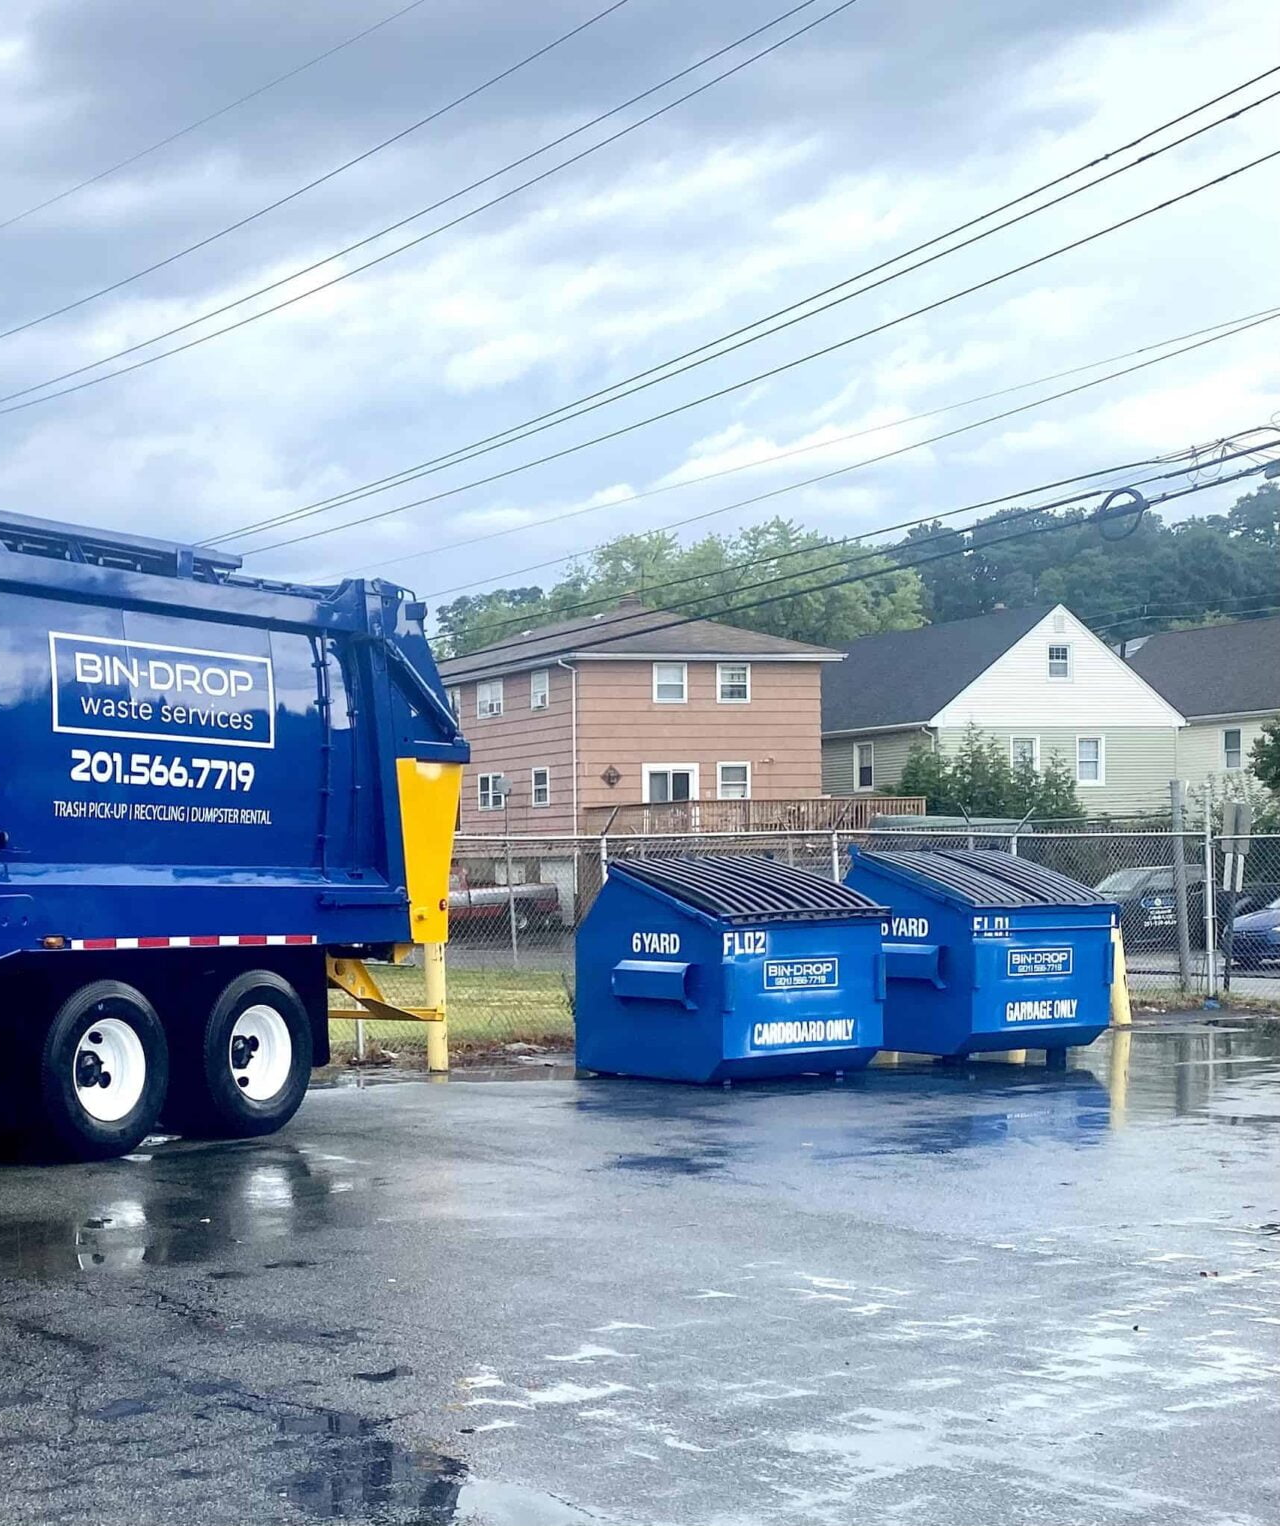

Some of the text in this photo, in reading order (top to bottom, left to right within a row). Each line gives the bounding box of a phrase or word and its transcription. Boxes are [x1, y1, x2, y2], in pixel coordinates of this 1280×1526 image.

[75, 651, 254, 698] BIN-DROP
[81, 696, 254, 731] waste services
[70, 748, 255, 792] 201.566.7719
[53, 800, 272, 825] TRASH PICK-UP RECYCLING DUMPSTER RENTAL
[891, 916, 929, 937] YARD
[632, 932, 681, 954] 6 YARD
[768, 963, 833, 977] BIN-DROP
[1012, 952, 1068, 965] BIN-DROP
[1006, 999, 1078, 1023] GARBAGE ONLY
[754, 1018, 855, 1046] CARDBOARD ONLY
